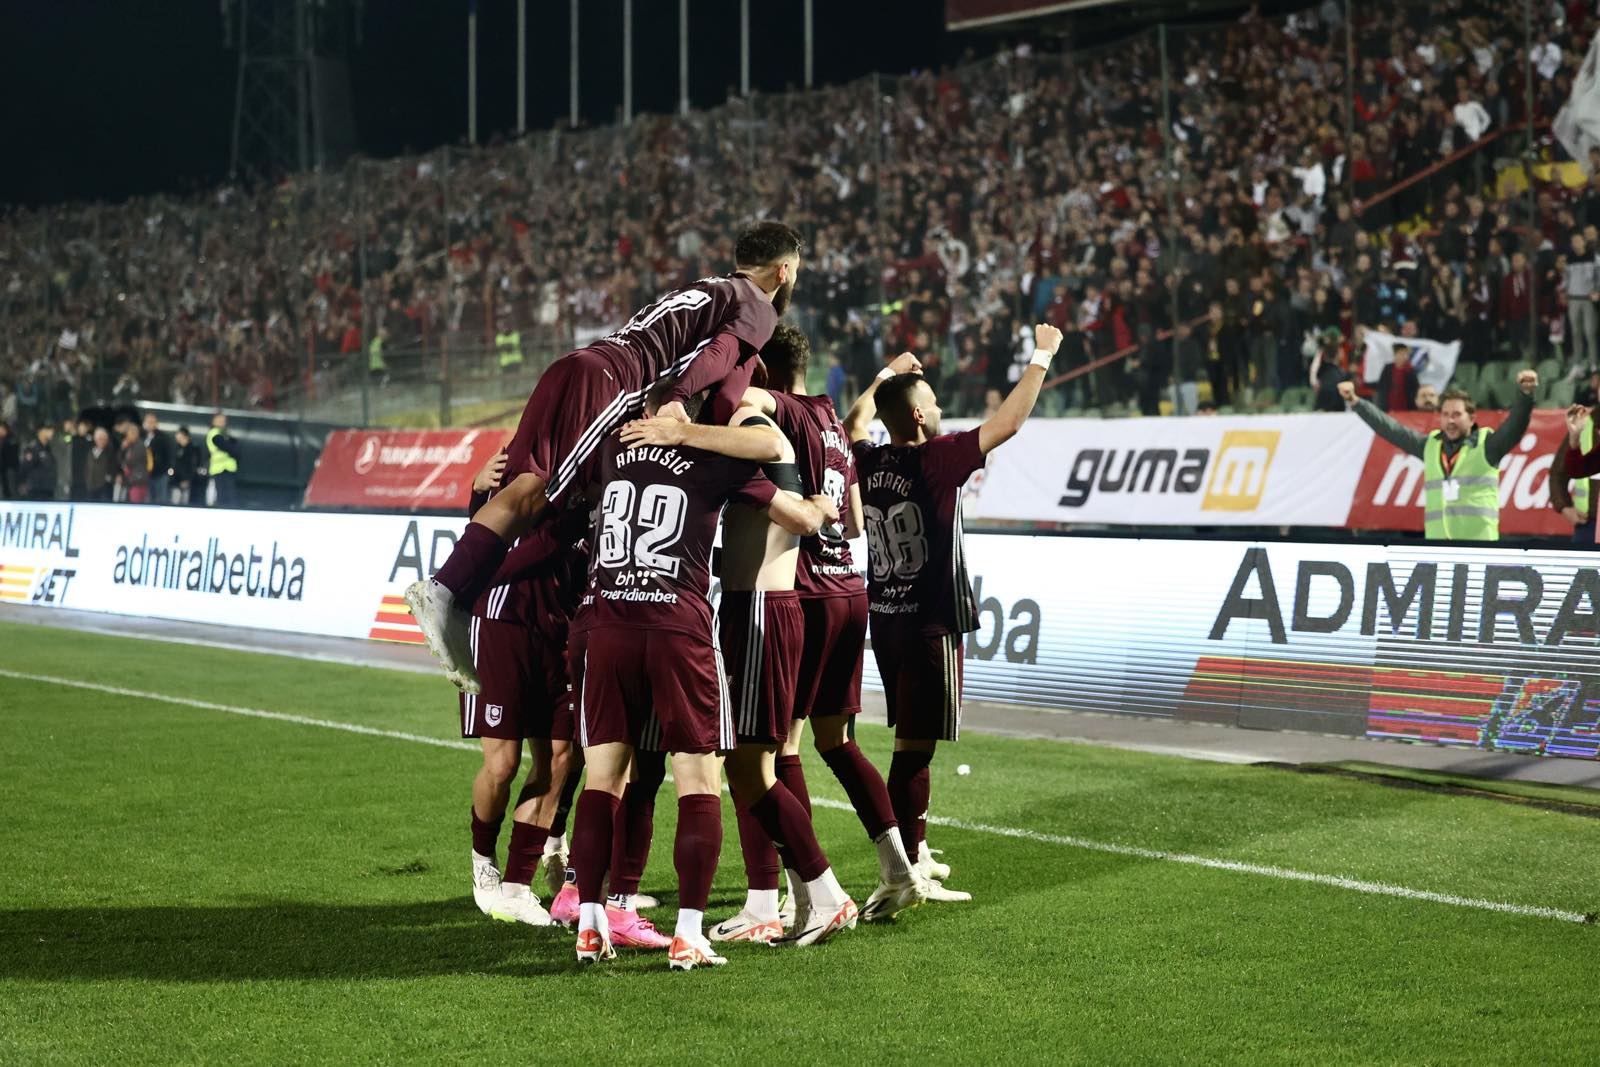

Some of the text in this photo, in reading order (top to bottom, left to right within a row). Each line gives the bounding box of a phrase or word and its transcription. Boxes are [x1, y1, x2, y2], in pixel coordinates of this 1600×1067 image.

[1058, 447, 1210, 507] guma
[0, 504, 79, 557] MIRAL
[600, 480, 688, 579] 32
[113, 533, 305, 601] admiralbet.ba
[601, 589, 678, 604] meridianbet
